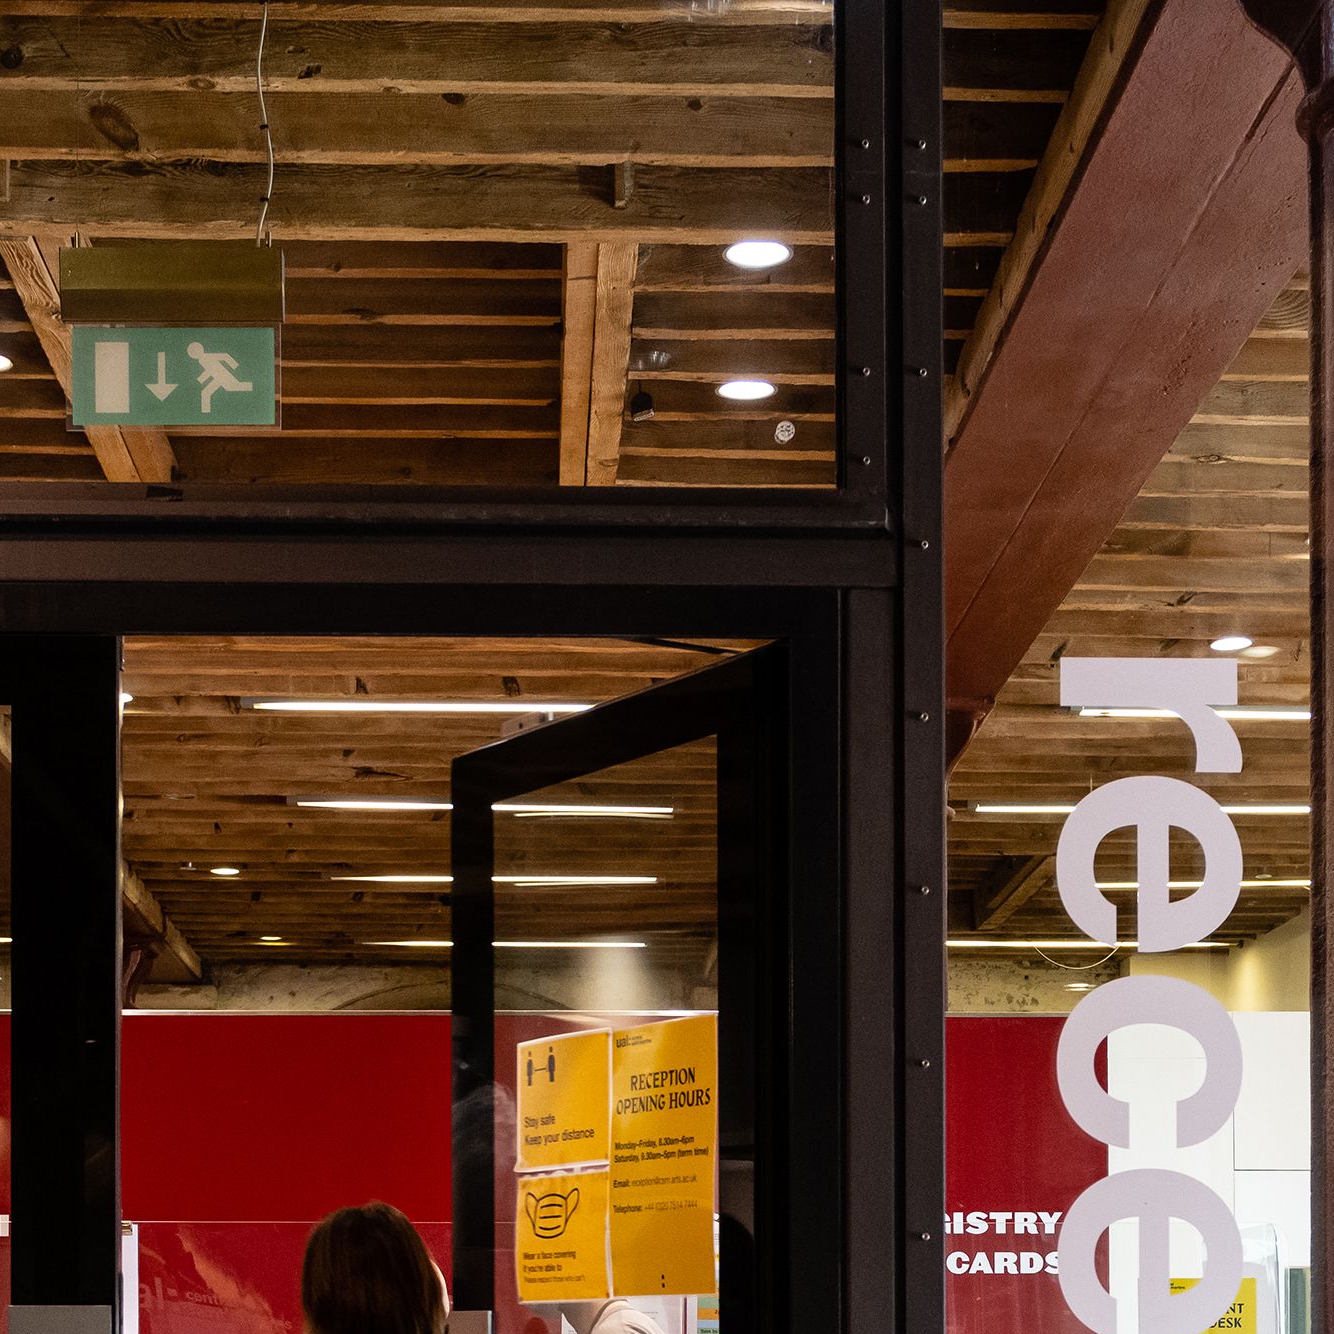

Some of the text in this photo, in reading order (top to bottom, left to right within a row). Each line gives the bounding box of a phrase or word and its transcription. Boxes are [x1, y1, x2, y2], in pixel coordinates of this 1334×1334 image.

[630, 1067, 695, 1092] RECEPTION
[616, 1088, 711, 1115] OPENING HOURS
[524, 1113, 555, 1129] Stay safe
[525, 1128, 595, 1146] Keep your distance
[944, 1212, 1063, 1234] ISTRY
